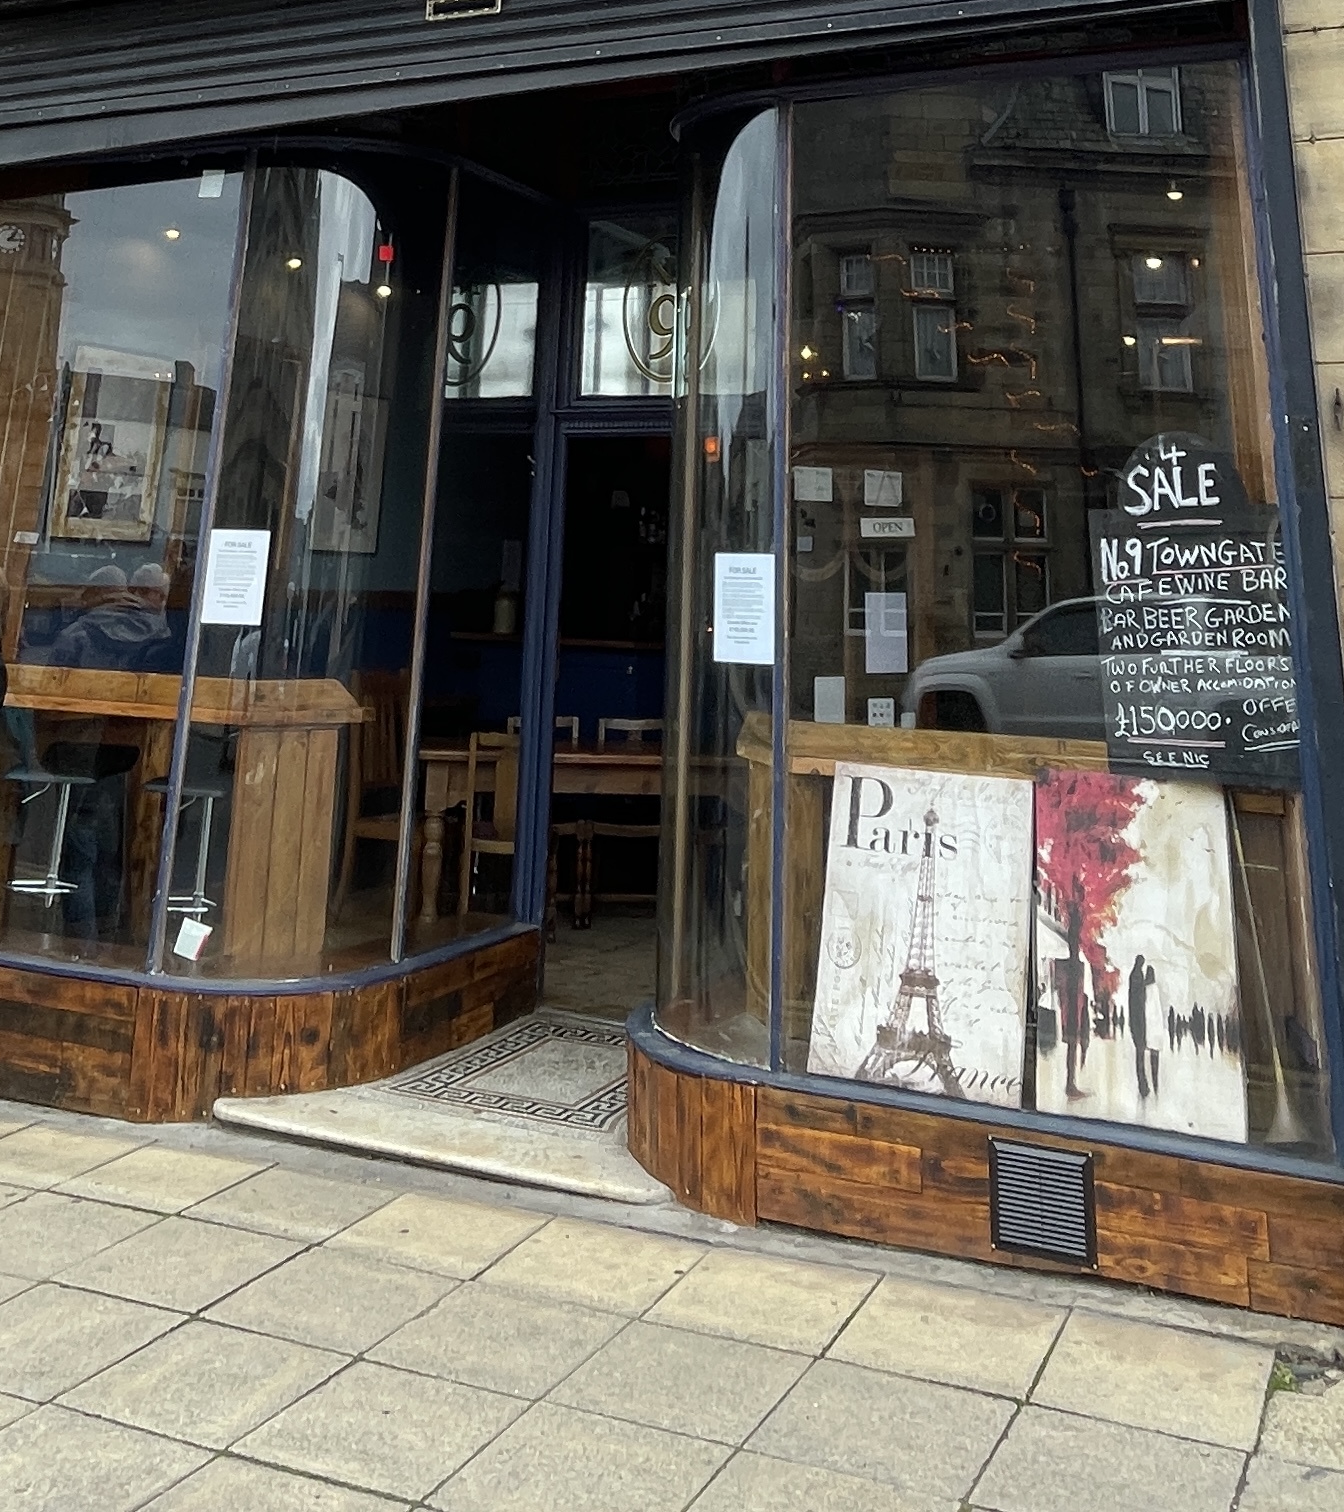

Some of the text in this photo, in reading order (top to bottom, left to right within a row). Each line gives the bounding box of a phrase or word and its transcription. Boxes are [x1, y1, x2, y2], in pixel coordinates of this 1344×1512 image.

[1123, 462, 1220, 516] SALE
[872, 521, 904, 534] OPEN
[1146, 537, 1286, 575] TOWNGATE
[1240, 569, 1288, 593] BAR
[1101, 607, 1141, 635] BAR
[1142, 605, 1203, 631] BEER
[1150, 629, 1228, 648] GARDEN
[1232, 627, 1292, 649] ROOM
[1101, 656, 1138, 677] TWO
[1225, 655, 1290, 673] FLOORS
[1110, 679, 1135, 694] OF
[1139, 677, 1192, 693] OWNER
[1143, 750, 1210, 766] SEE NIC
[840, 773, 959, 861] Paris
